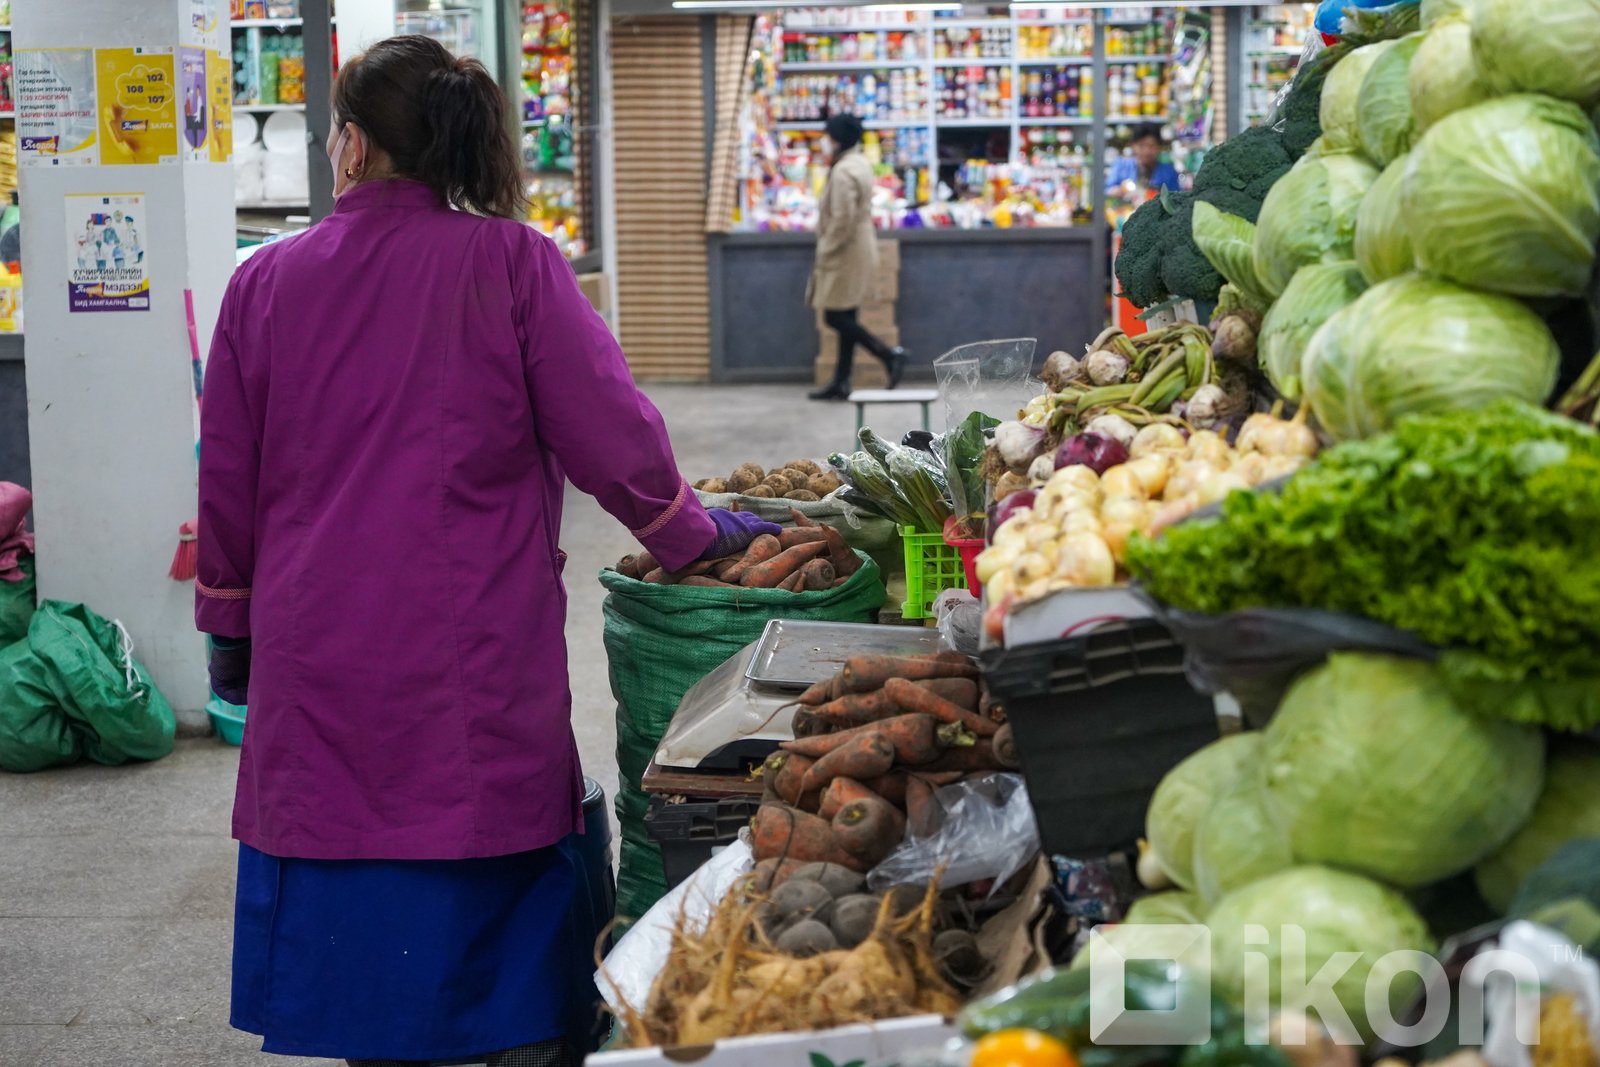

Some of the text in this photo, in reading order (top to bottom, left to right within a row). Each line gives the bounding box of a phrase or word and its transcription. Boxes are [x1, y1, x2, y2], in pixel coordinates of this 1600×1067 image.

[147, 73, 163, 82] 102
[126, 85, 144, 93] 108
[148, 95, 165, 104] 107
[105, 283, 143, 292] МЭДЭЭЛ
